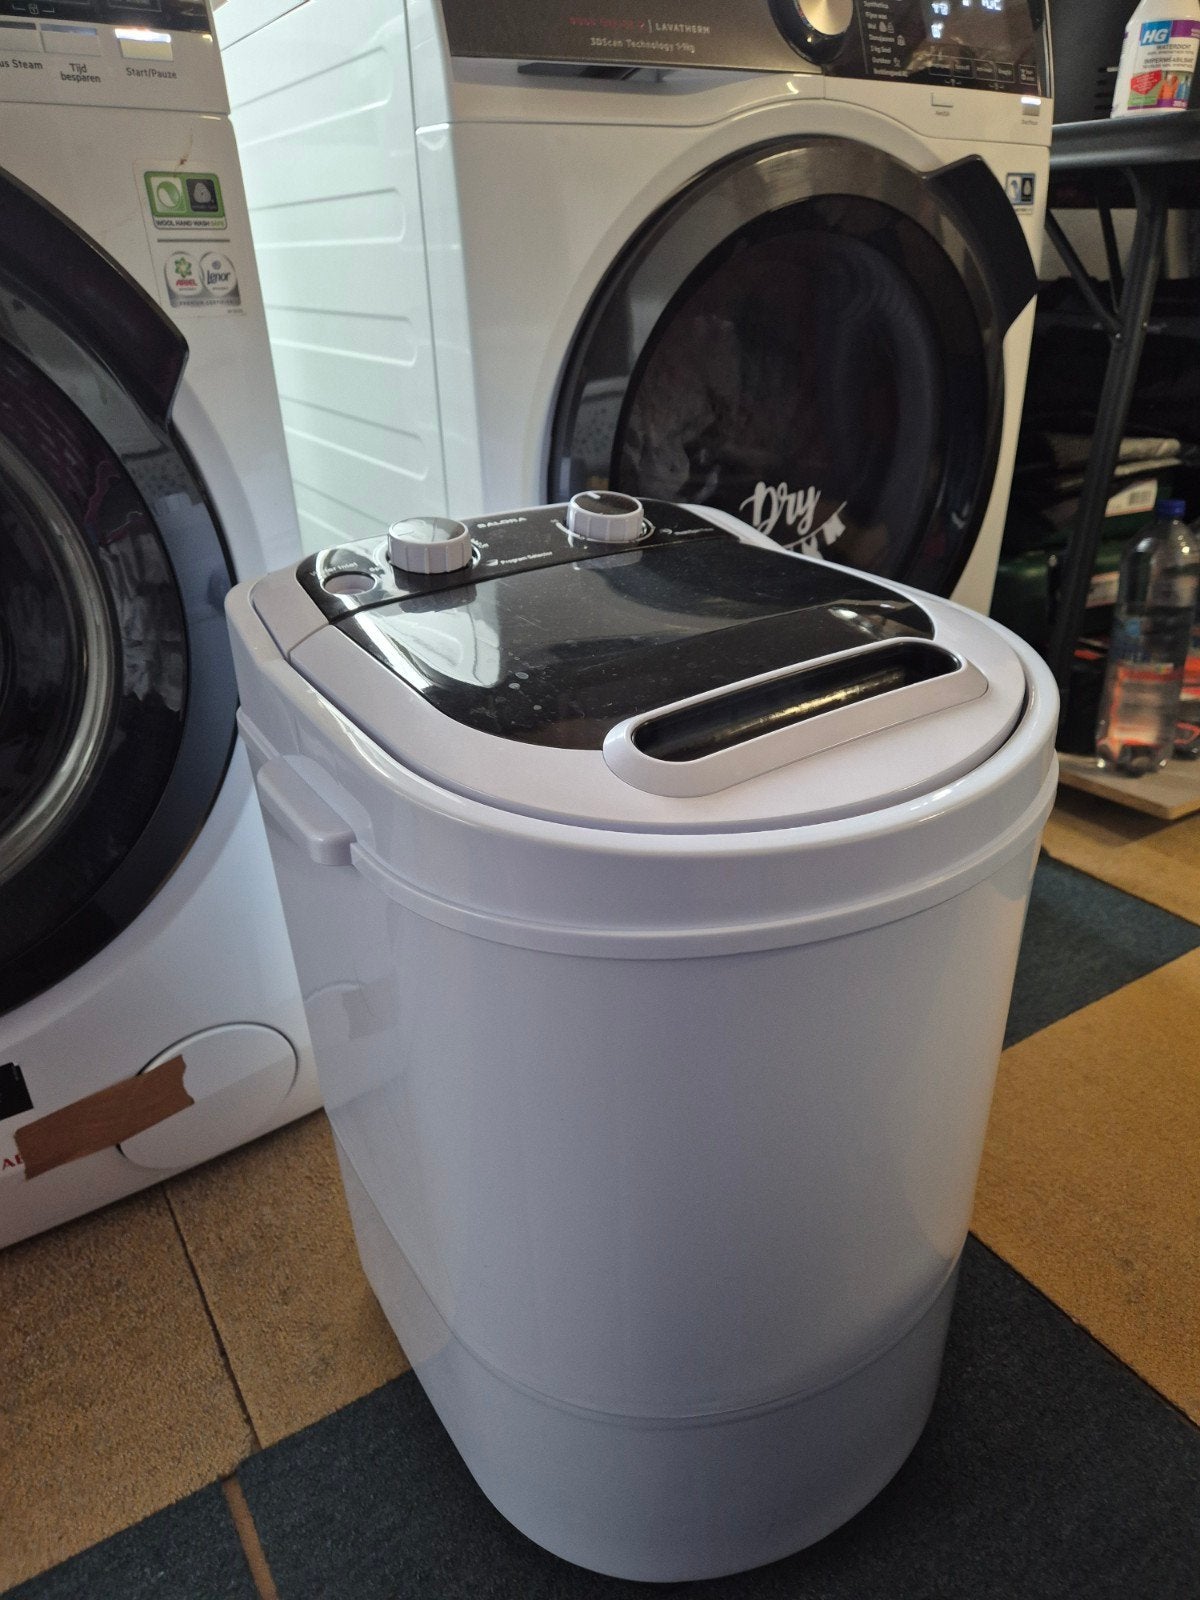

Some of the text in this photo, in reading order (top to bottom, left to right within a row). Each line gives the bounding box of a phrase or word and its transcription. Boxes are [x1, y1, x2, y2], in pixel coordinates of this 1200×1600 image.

[655, 22, 710, 34] LAVATHERM
[1142, 28, 1168, 44] HG
[625, 39, 673, 52] Technology
[12, 59, 43, 70] Steam
[69, 63, 87, 74] Tijd
[60, 71, 101, 83] besparen
[126, 67, 177, 79] Start/Pauze
[207, 270, 231, 284] Lenor
[739, 481, 822, 536] Dry
